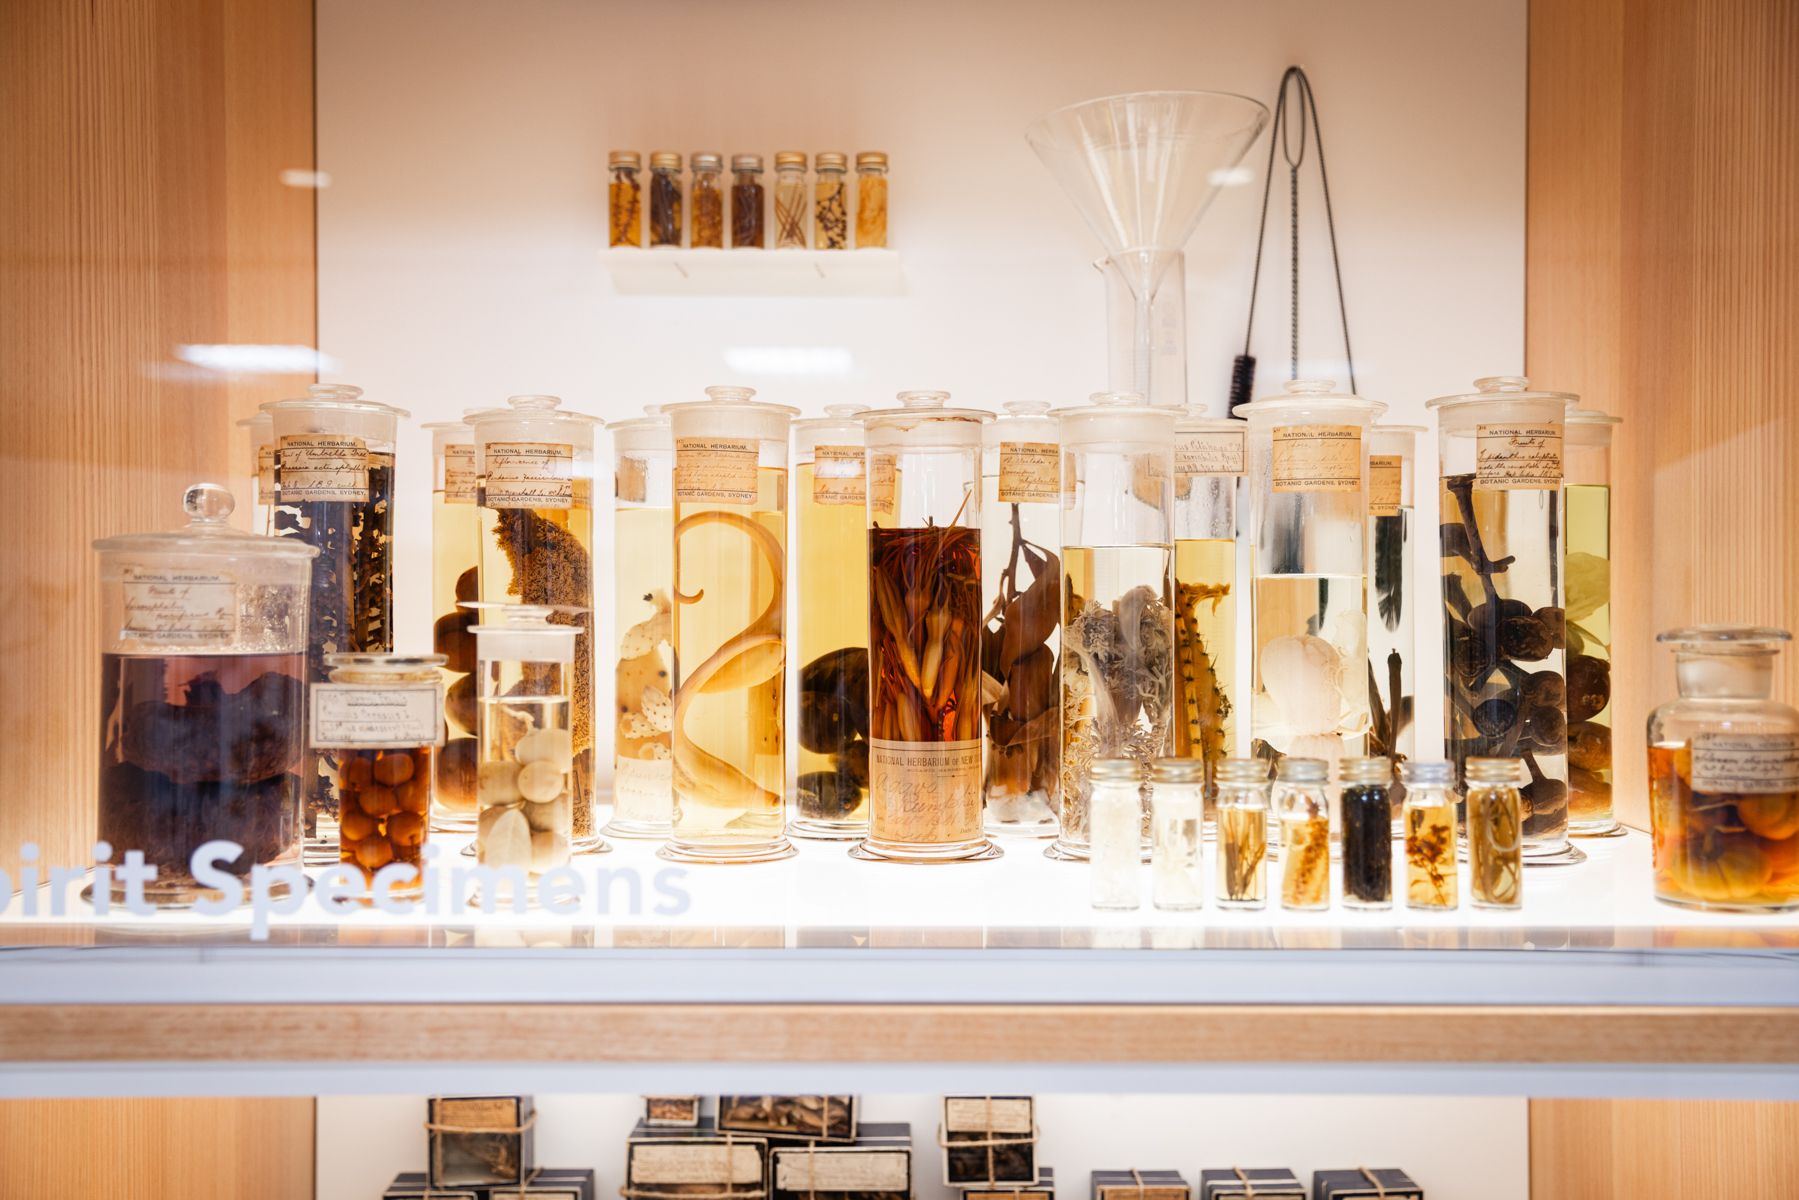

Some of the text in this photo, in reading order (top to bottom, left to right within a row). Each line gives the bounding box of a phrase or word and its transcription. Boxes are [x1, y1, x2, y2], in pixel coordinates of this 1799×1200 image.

[876, 754, 905, 767] NATIONAL
[907, 755, 950, 767] HERBARIUM
[0, 840, 692, 941] irit Specimens
